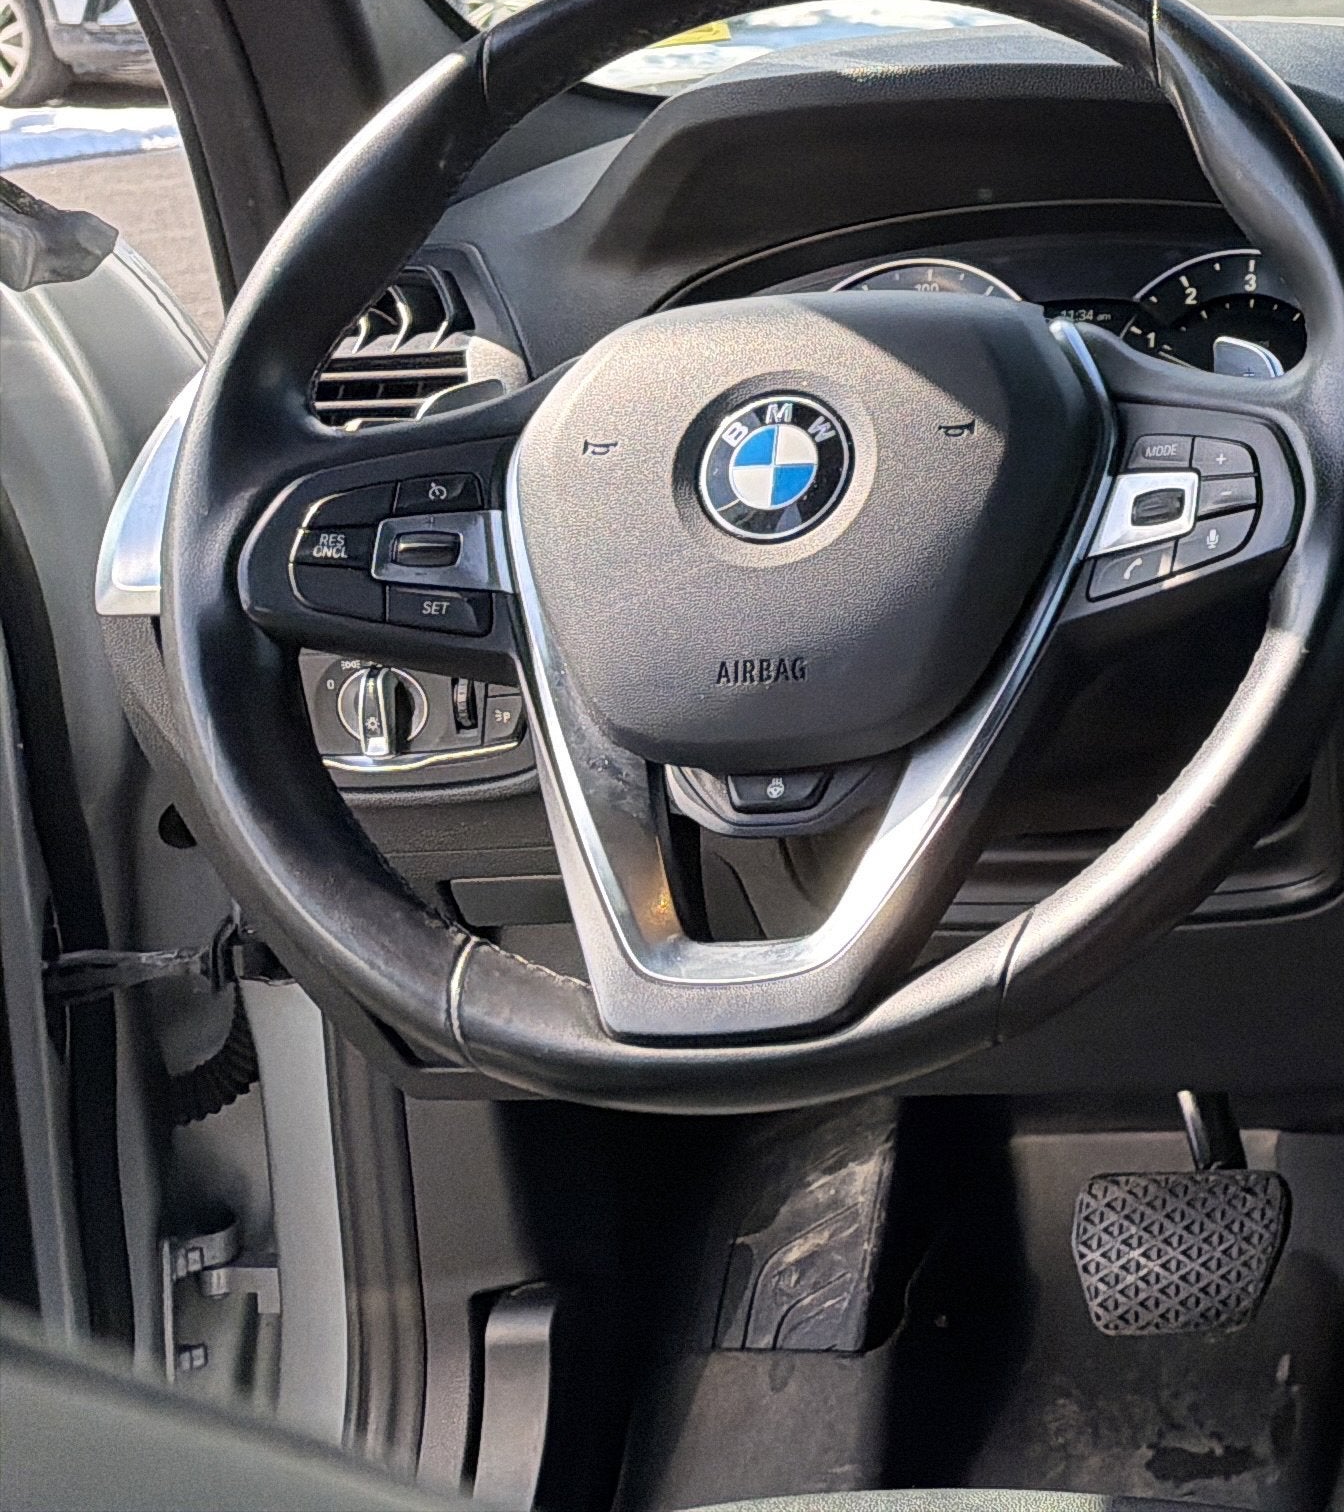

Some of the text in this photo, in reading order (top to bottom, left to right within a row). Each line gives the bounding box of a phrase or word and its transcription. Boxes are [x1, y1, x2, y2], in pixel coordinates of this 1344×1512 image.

[1244, 274, 1257, 292] 3
[1185, 287, 1198, 305] 2
[1146, 331, 1156, 349] 1
[721, 402, 836, 448] BMW
[1144, 443, 1178, 458] MODE
[319, 533, 345, 547] RES
[312, 544, 349, 559] CNCL
[422, 601, 450, 616] SET
[716, 656, 807, 687] AIRBAG
